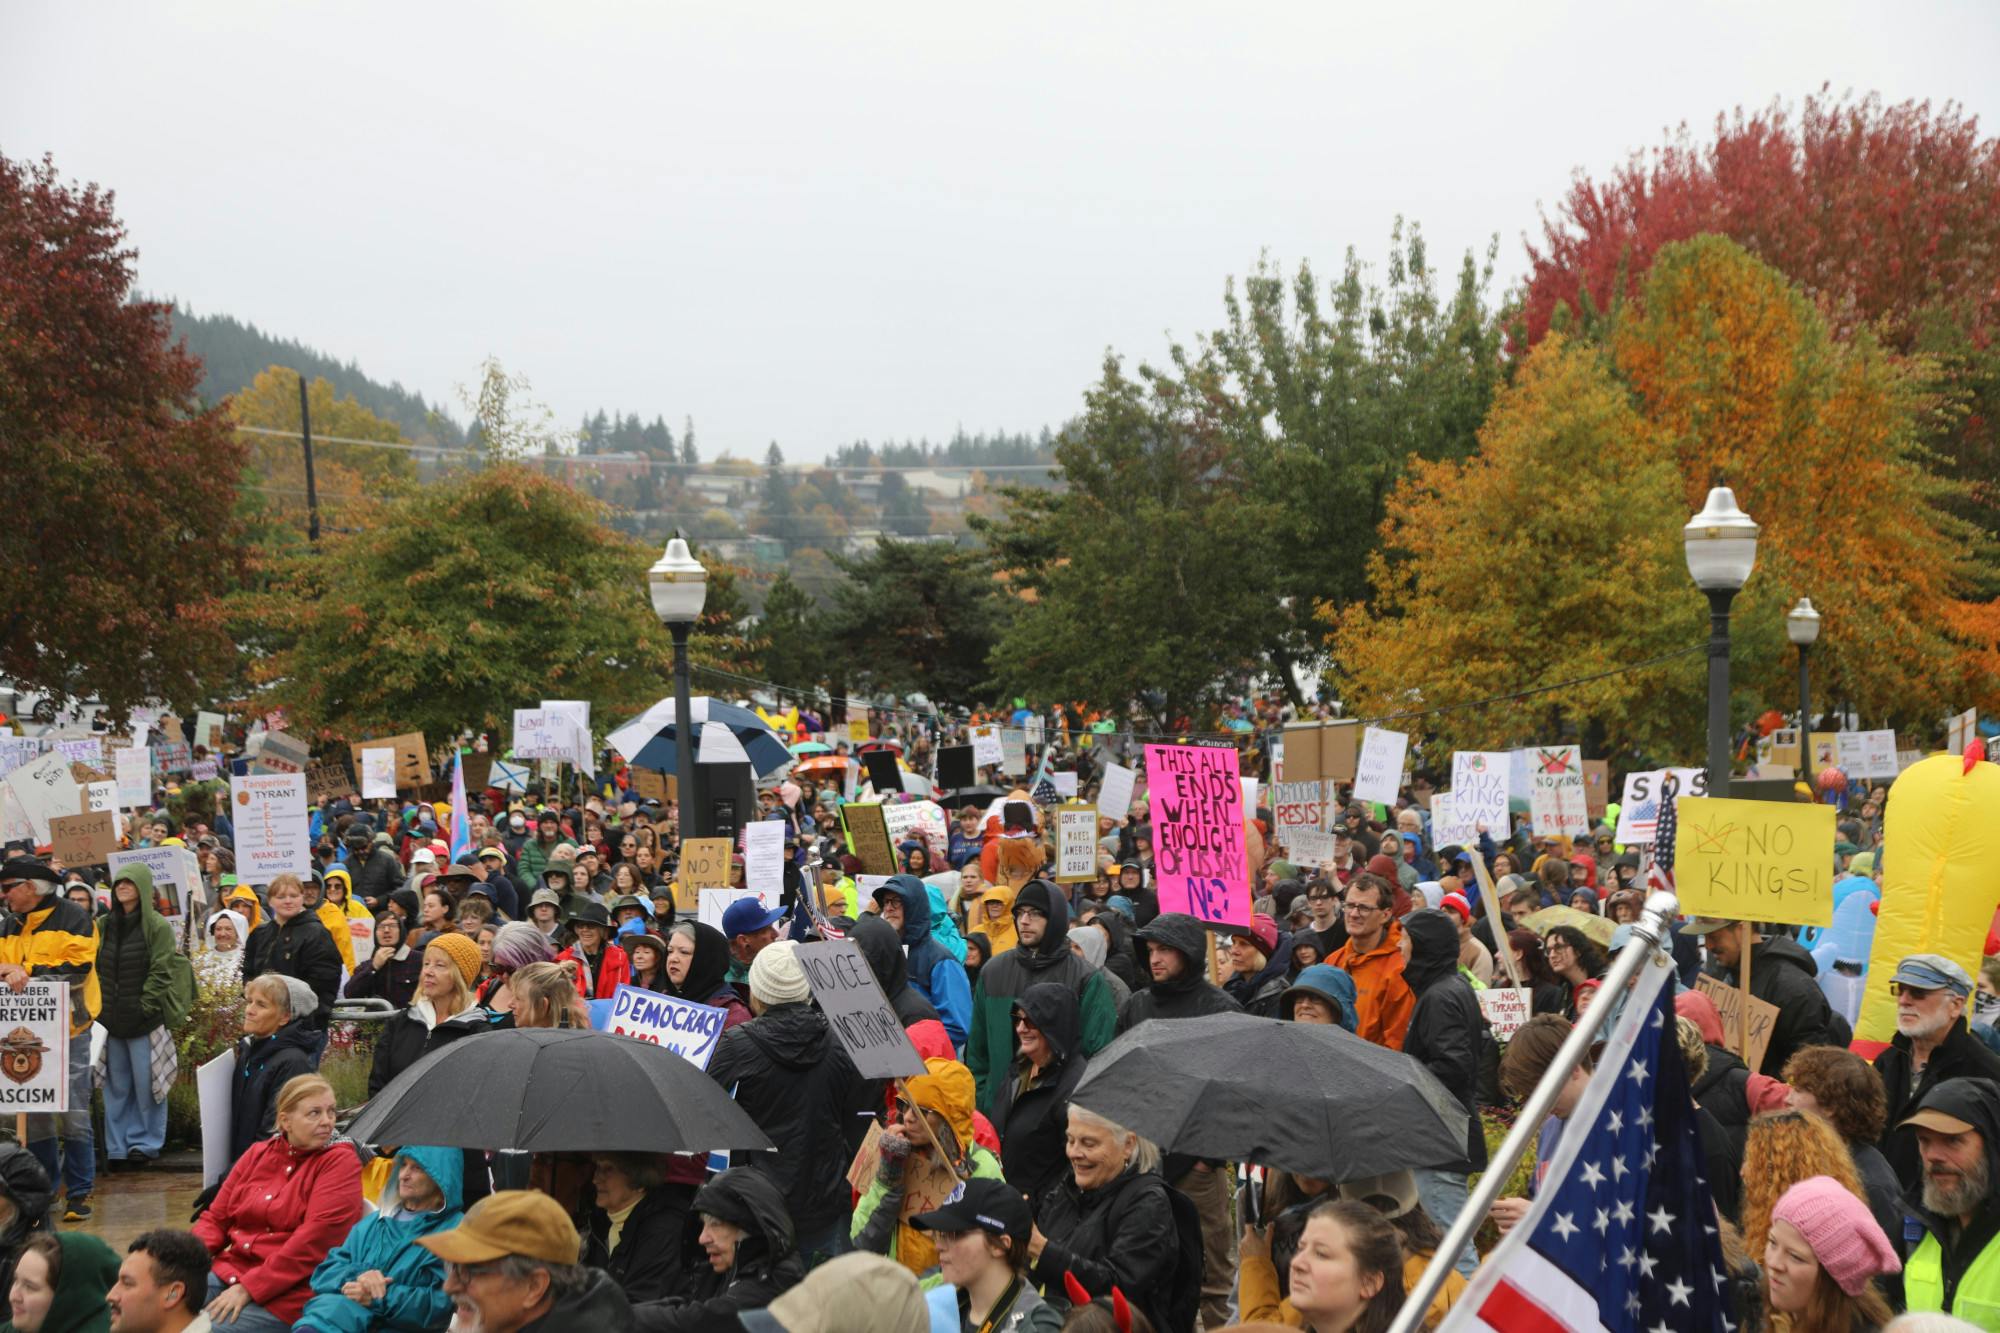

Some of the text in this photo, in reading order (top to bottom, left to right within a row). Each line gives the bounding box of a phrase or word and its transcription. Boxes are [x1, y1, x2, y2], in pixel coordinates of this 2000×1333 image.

[1155, 749, 1234, 775] THIS ALL
[242, 778, 292, 789] Tangerine
[1456, 772, 1501, 789] FAUX
[1536, 775, 1584, 788] NO KINGS
[88, 788, 109, 797] NOT
[256, 789, 296, 799] TYRANT
[1175, 774, 1237, 803] ENDS
[1456, 789, 1504, 806] KING
[1062, 814, 1077, 824] LOVE
[1276, 802, 1330, 825] RESIST
[1456, 808, 1502, 822] WAY
[1543, 814, 1584, 828] RIGHTS
[58, 819, 107, 840] Resist
[1068, 832, 1089, 840] MAKES
[1160, 823, 1237, 852] ENOUGH
[1746, 823, 1794, 856] NO
[118, 851, 173, 864] Immigrants
[252, 850, 295, 859] WAKE UP
[1065, 845, 1094, 856] AMERICA
[258, 861, 293, 870] America
[687, 859, 710, 873] NO
[1067, 861, 1089, 871] GREAT
[1160, 848, 1243, 881] OF US SAY
[1708, 862, 1818, 901] KINGS!
[1187, 877, 1229, 919] NO
[830, 954, 871, 991] ICE
[15, 997, 34, 1006] YOU
[37, 997, 57, 1006] CAN
[615, 990, 726, 1057] DEMOCRACY
[1504, 1013, 1513, 1021] IN
